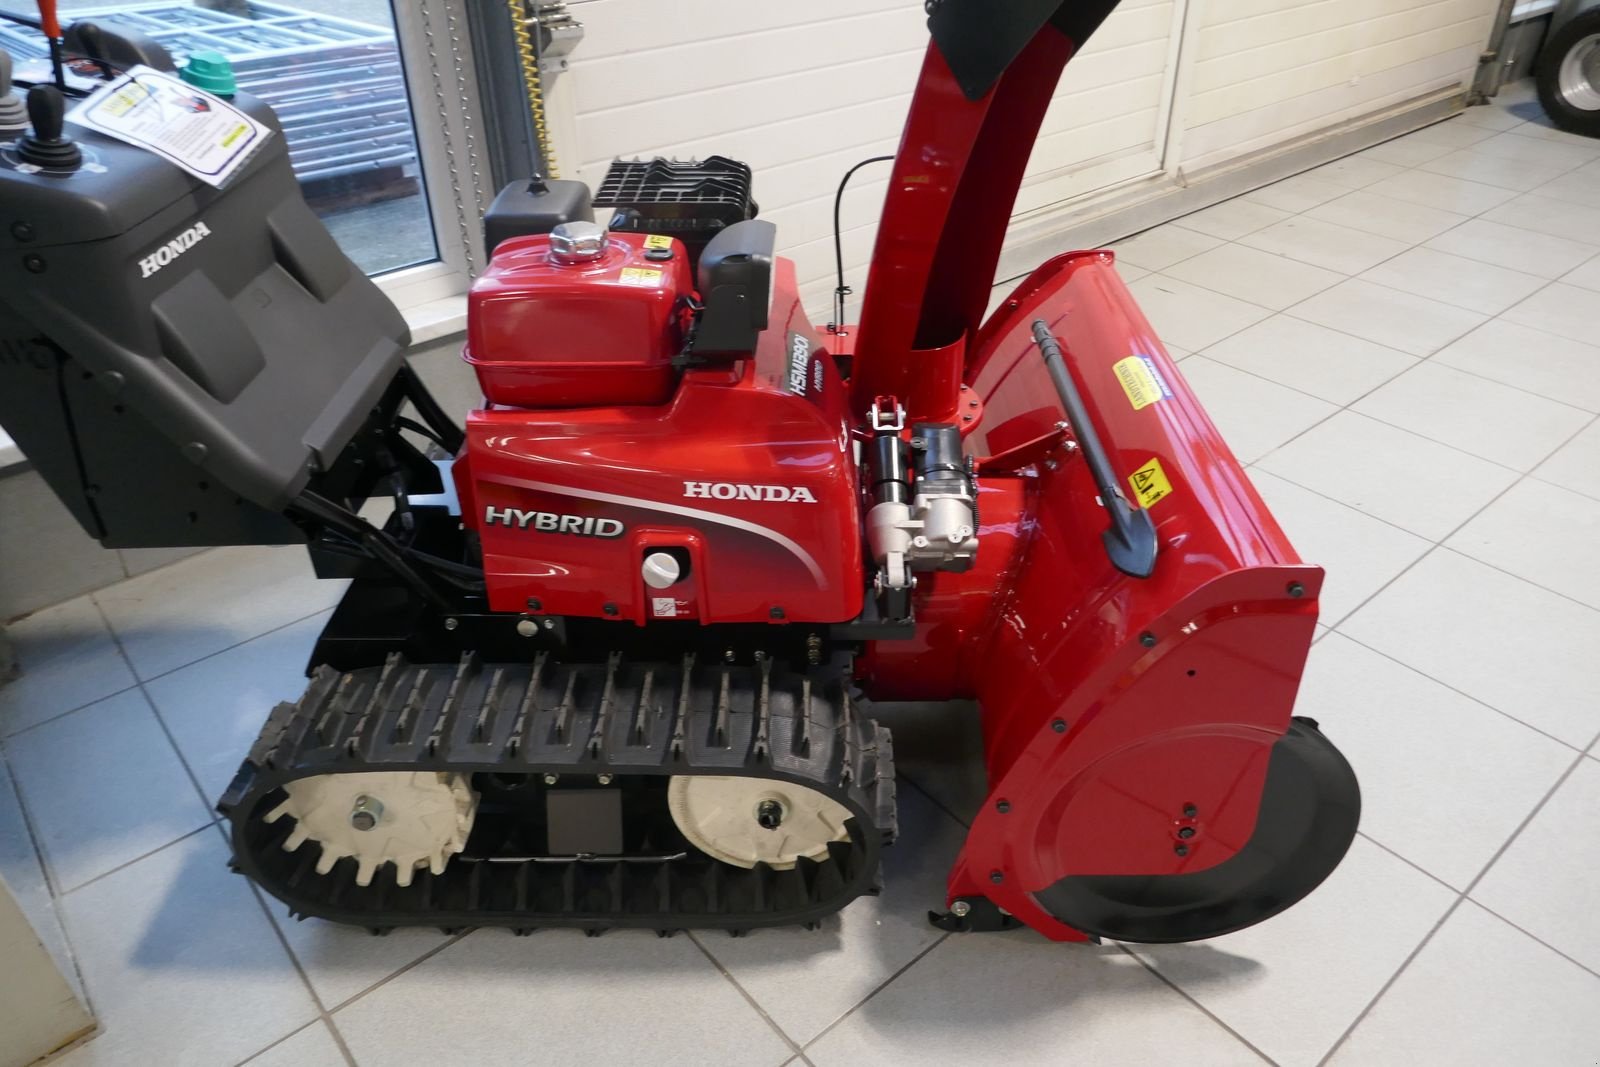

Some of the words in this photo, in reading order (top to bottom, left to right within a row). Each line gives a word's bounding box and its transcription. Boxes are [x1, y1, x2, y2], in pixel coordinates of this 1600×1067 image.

[138, 221, 212, 278] HONDA
[683, 481, 818, 503] HONDA
[484, 505, 625, 538] HYBRID
